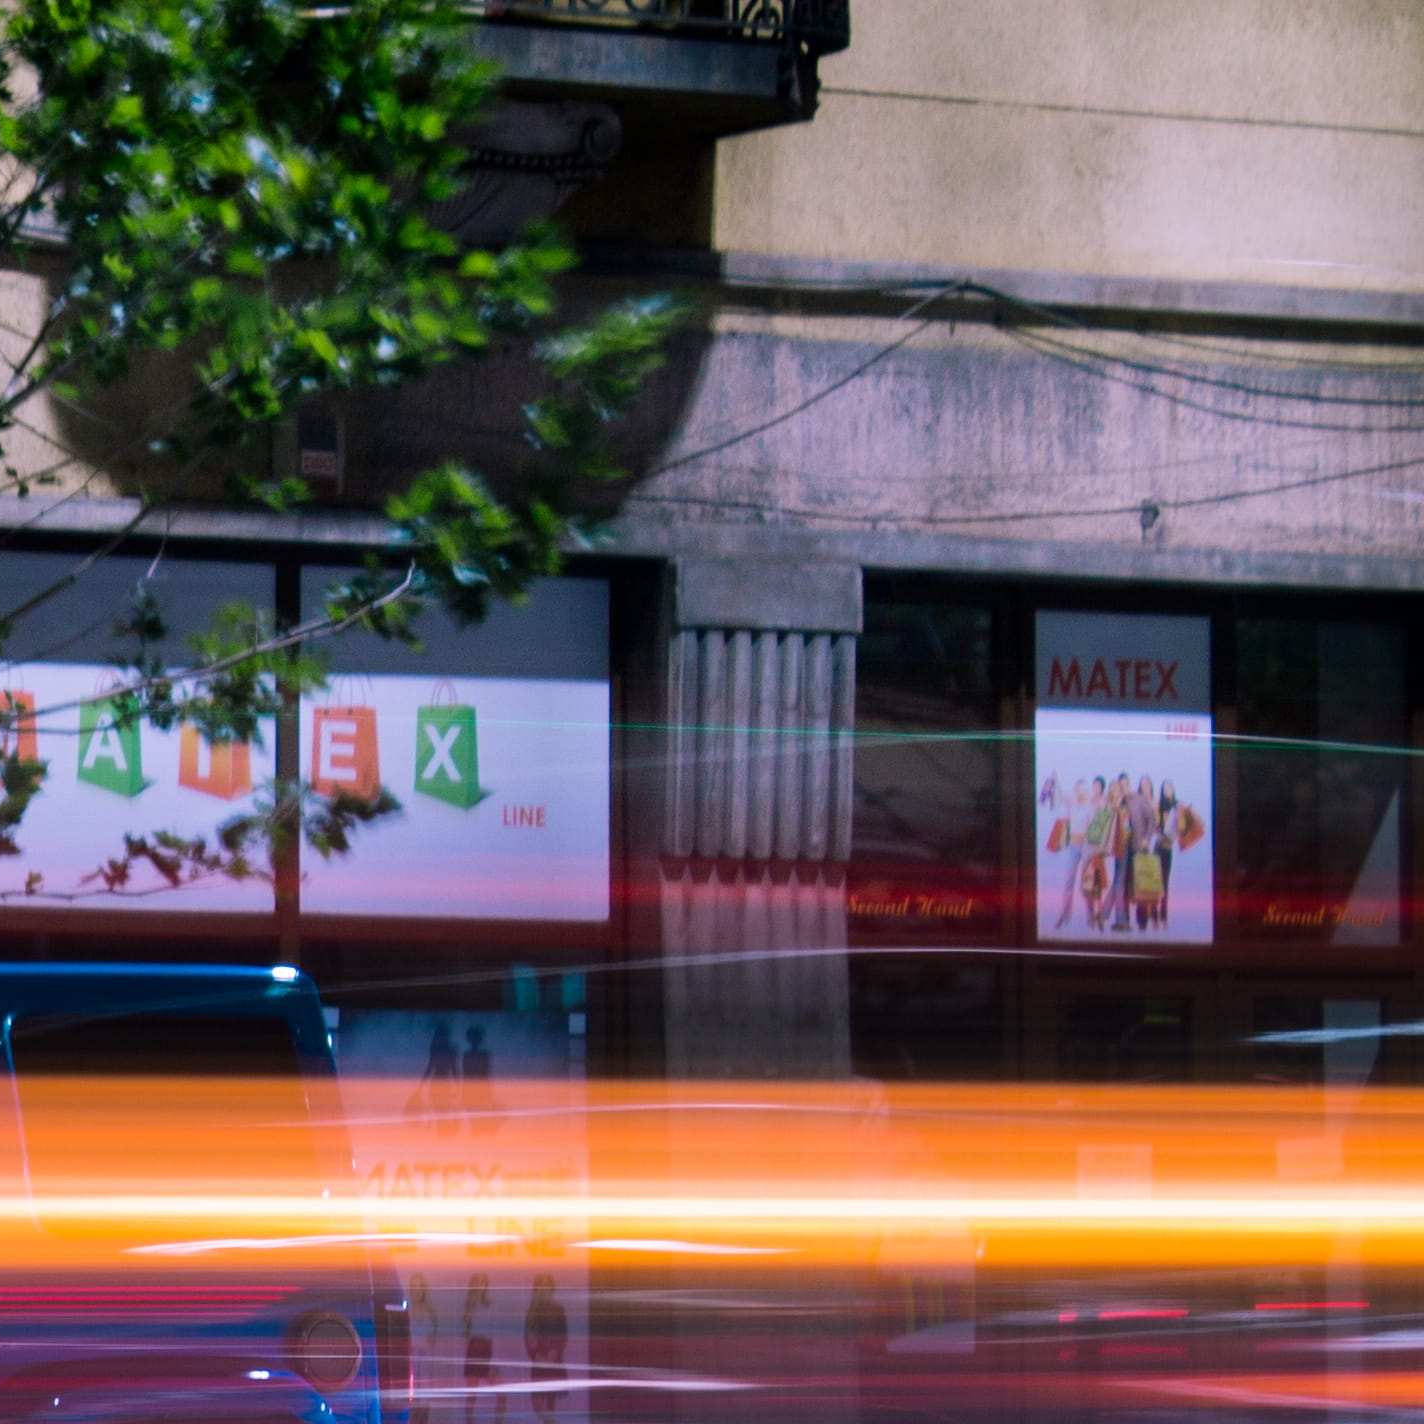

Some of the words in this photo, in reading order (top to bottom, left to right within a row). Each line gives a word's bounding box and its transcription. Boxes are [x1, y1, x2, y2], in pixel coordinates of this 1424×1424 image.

[1048, 655, 1180, 702] MATEX
[502, 804, 546, 829] LINE
[467, 1214, 566, 1257] LINE
